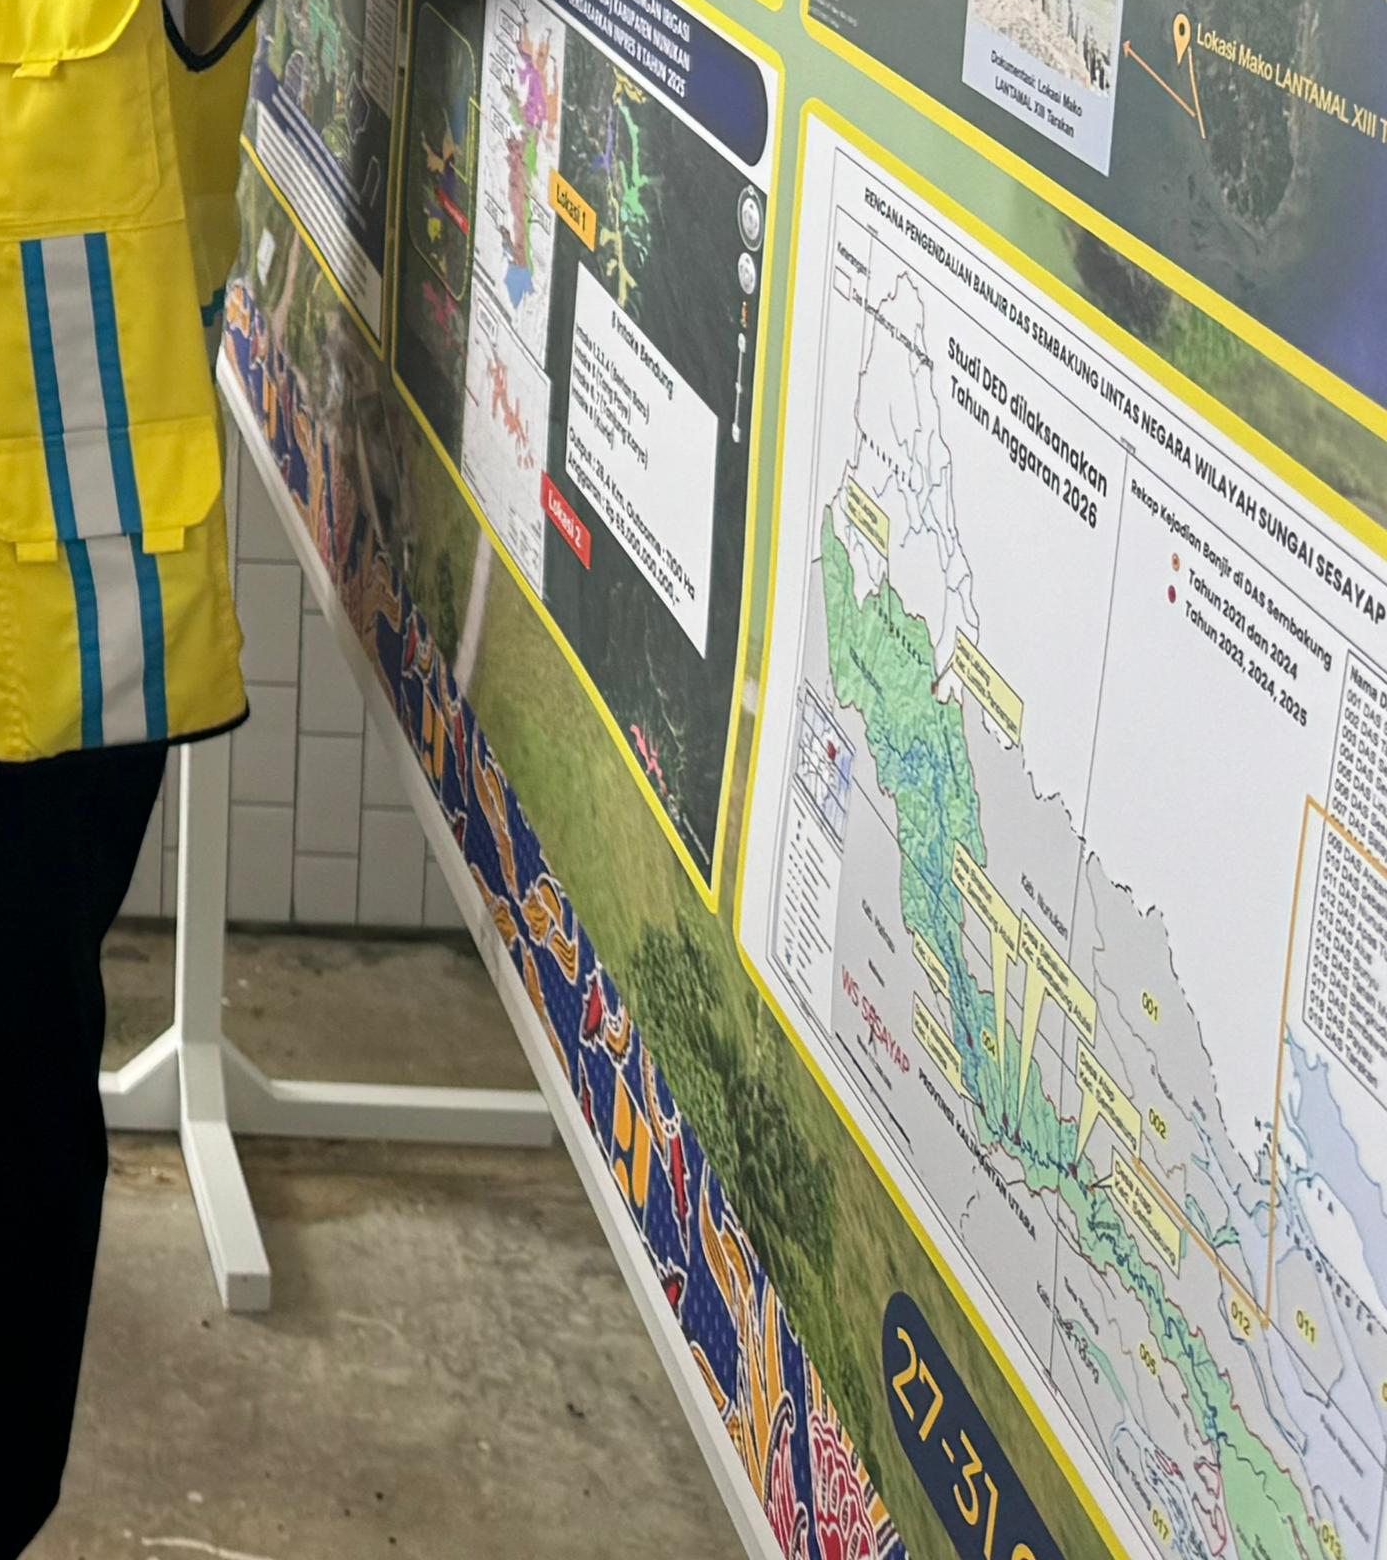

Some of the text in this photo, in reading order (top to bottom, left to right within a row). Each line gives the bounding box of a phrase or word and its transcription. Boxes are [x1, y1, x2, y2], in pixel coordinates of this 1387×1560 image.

[1197, 22, 1237, 62] Lokasi
[1238, 43, 1273, 81] Mako
[1275, 63, 1349, 124] LANTAMAL
[1351, 103, 1377, 138] XIII
[865, 187, 1386, 625] RENCANA PENGENDALIAN BANJIR DAS SEMBAKUNG LINTAS NEGARA WILAYAH SUNGAI SESAYAP
[948, 336, 1108, 498] Studi DED dilaksanakan
[950, 375, 1098, 531] Tahun Anggaran 2026
[1130, 479, 1332, 672] Rekap Kejadian Banjir di DAS Sembakung
[1188, 568, 1299, 680] Tahun 2021 dan 2024
[1185, 600, 1308, 728] Tahun 2023, 2024, 2025
[1350, 665, 1378, 702] Nama
[1346, 688, 1381, 729] 001 DAS
[1348, 810, 1367, 840] DAS
[1337, 899, 1356, 928] DAS
[1141, 991, 1159, 1021] 001
[1148, 1107, 1167, 1139] 002
[1230, 1301, 1252, 1337] 012
[1295, 1309, 1316, 1343] 011
[1139, 1342, 1157, 1377] 005
[892, 1326, 944, 1442] 27
[953, 1429, 999, 1560] 31
